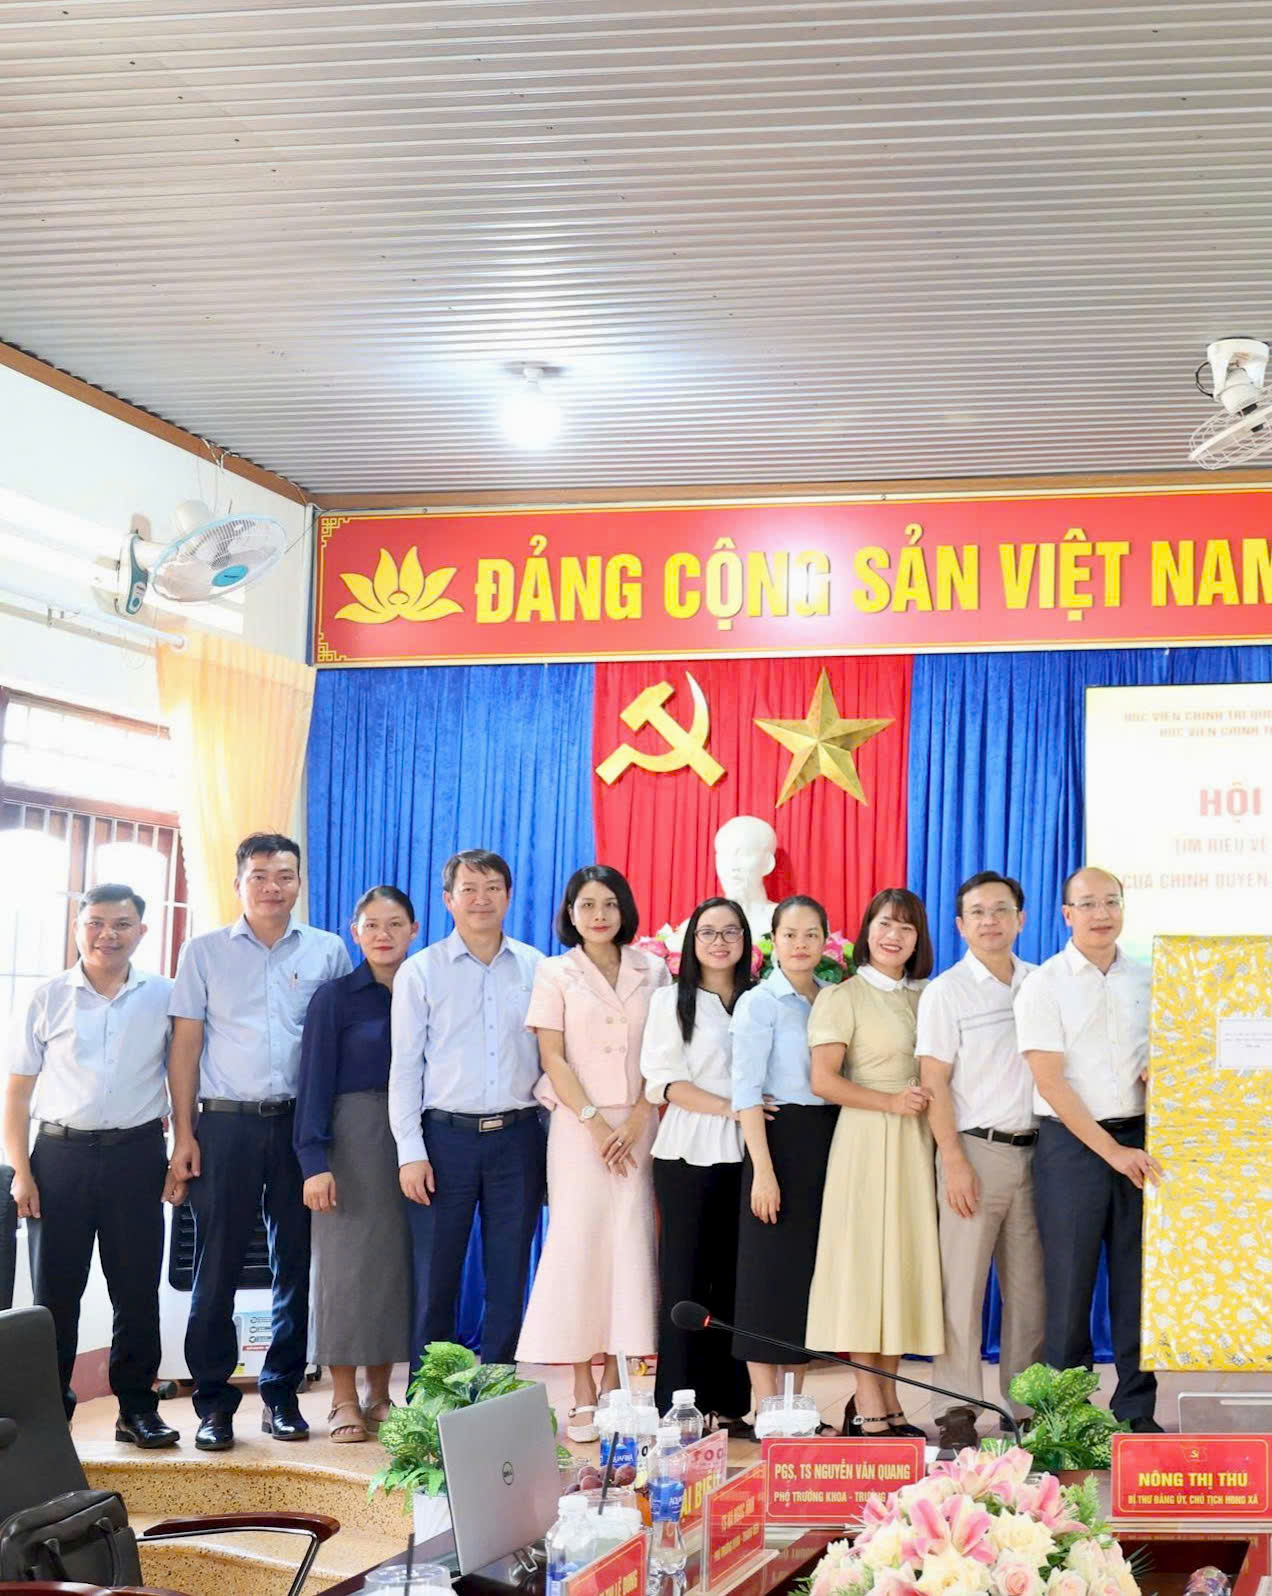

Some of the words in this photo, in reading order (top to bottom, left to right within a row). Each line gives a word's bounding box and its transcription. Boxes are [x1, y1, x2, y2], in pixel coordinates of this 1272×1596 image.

[475, 534, 642, 623] ĐẢNG
[664, 536, 832, 631] CỘNG
[852, 522, 980, 614] SẢN
[998, 528, 1130, 623] VIỆT
[1199, 778, 1261, 824] HỘI
[814, 1458, 853, 1480] NGUYỄN
[856, 1461, 875, 1480] VĂN
[878, 1463, 911, 1482] QUANG
[1138, 1469, 1185, 1487] NÔNG
[1188, 1471, 1214, 1490] THỊ
